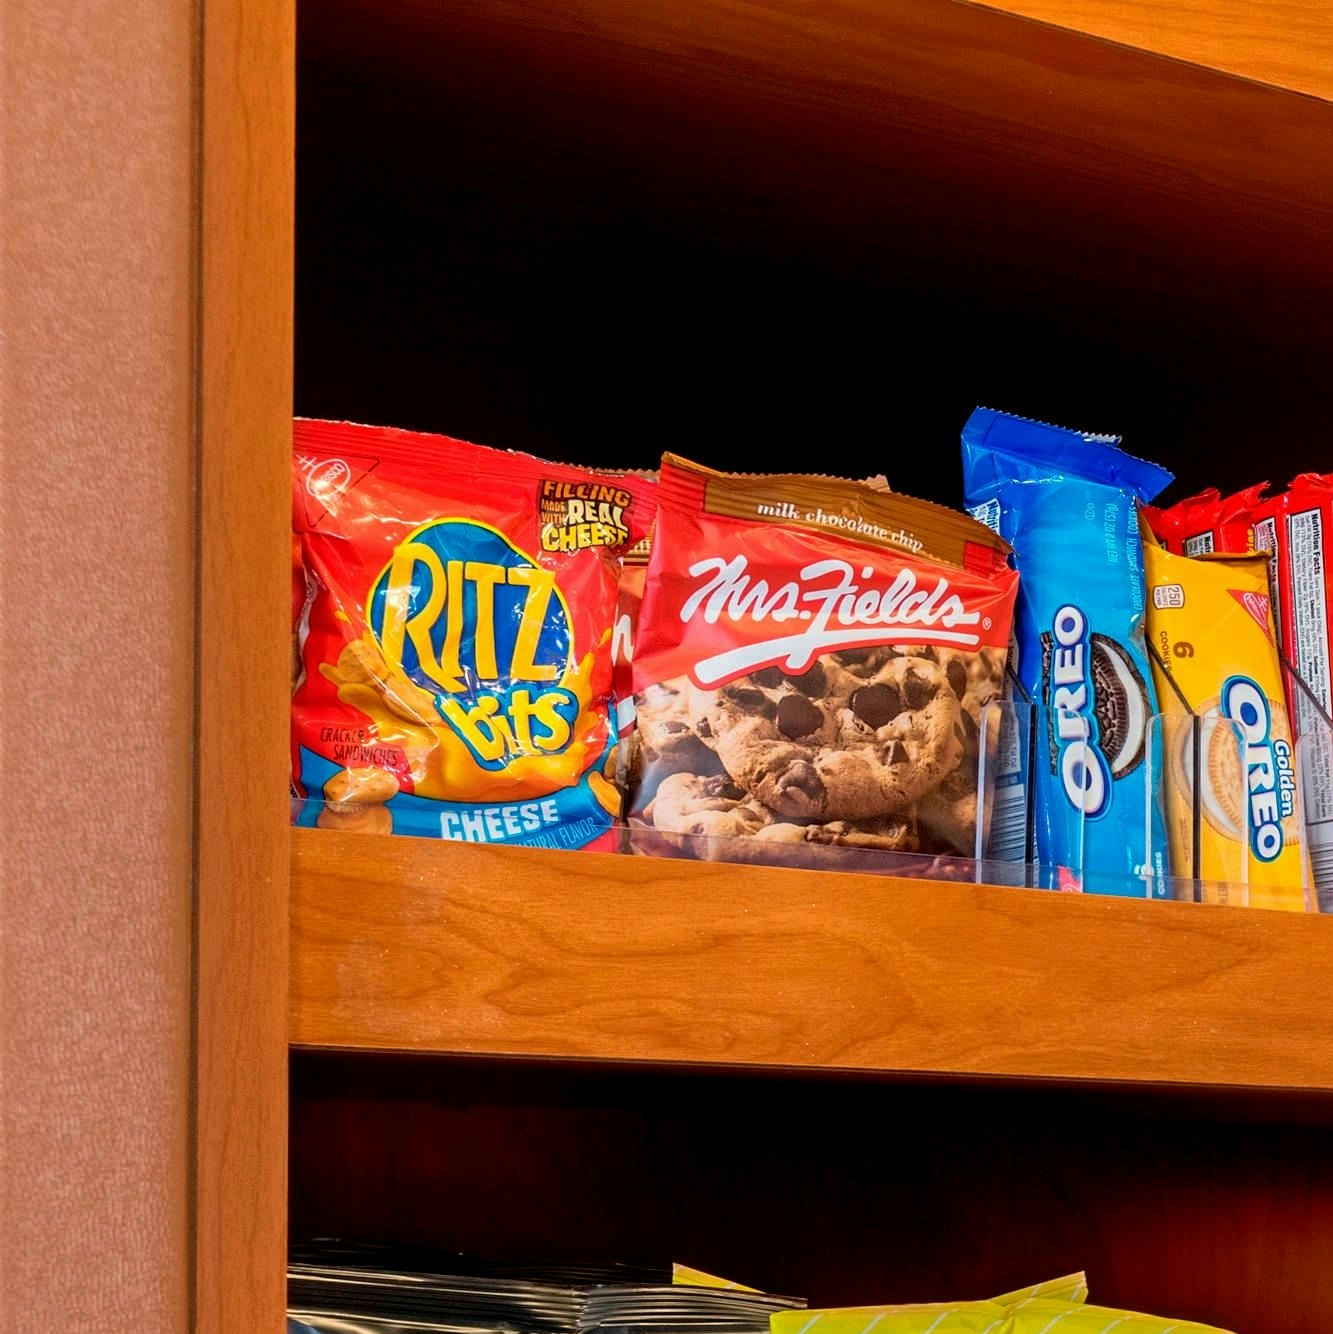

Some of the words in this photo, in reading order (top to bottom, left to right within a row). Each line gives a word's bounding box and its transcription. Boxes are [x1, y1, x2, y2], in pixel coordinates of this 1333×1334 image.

[543, 480, 632, 507] FILLING
[541, 499, 565, 512] MADE
[565, 500, 629, 532] REAL
[541, 511, 565, 525] WITH
[757, 502, 801, 520] milk
[805, 508, 889, 541] chocolate
[890, 527, 924, 554] chip
[1310, 513, 1320, 550] Nutrition
[541, 522, 629, 553] CHEESE
[1312, 549, 1322, 576] Facts
[799, 558, 981, 640] Fields
[1167, 586, 1181, 607] 250
[380, 543, 555, 695] RITZ
[1172, 640, 1195, 660] 6
[440, 687, 572, 762] bits
[1052, 605, 1107, 813] OREO
[332, 744, 399, 766] SANDWICHES
[1228, 683, 1282, 860] OREO
[1272, 738, 1294, 819] Golden
[439, 800, 560, 843] CHEESE
